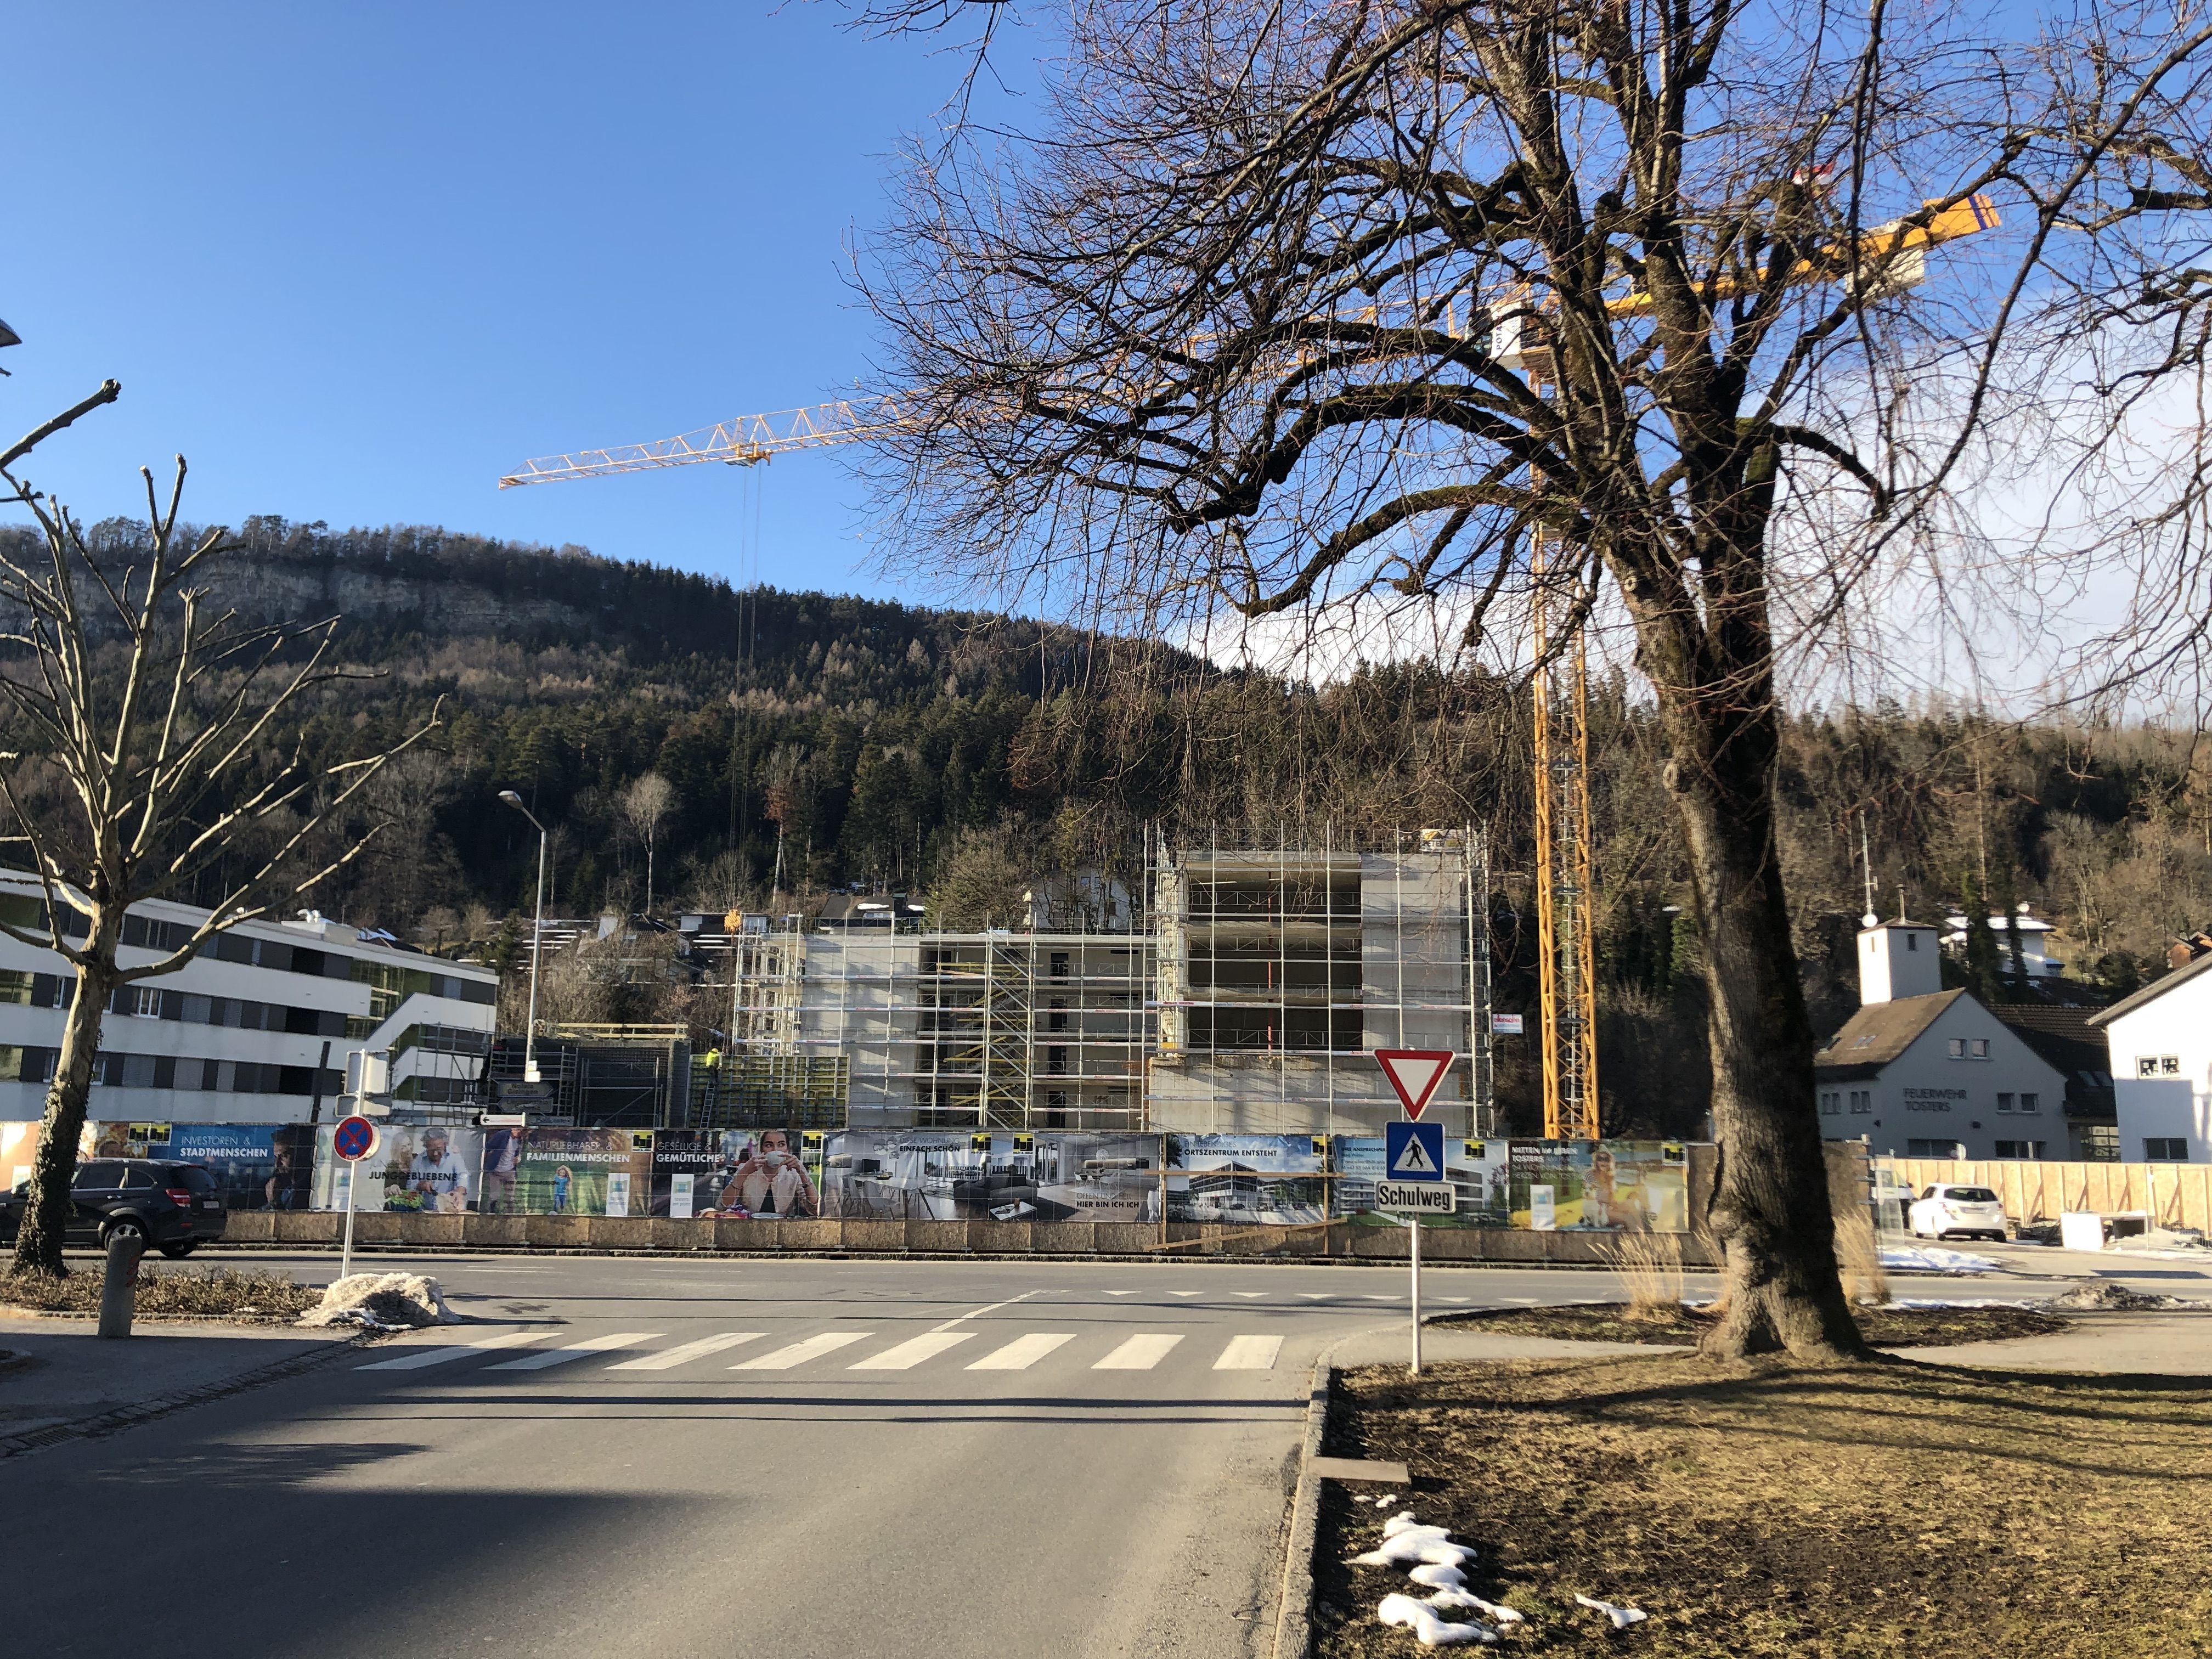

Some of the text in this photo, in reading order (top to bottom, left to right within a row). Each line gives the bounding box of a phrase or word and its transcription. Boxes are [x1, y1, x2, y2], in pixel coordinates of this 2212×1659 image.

[1903, 1088, 1966, 1099] FEUERWEHR
[181, 1136, 250, 1146] INVESTOREN &
[656, 1142, 712, 1151] GESELLIGE &
[179, 1147, 268, 1158] STADTMENSCHEN
[933, 1144, 960, 1152] SCHÖN
[526, 1152, 630, 1163] FAMILIENMENSCHEN
[656, 1152, 720, 1163] GEMÜTLICHE
[1511, 1155, 1545, 1163] TOSTERS
[1379, 1185, 1451, 1211] Schulweg
